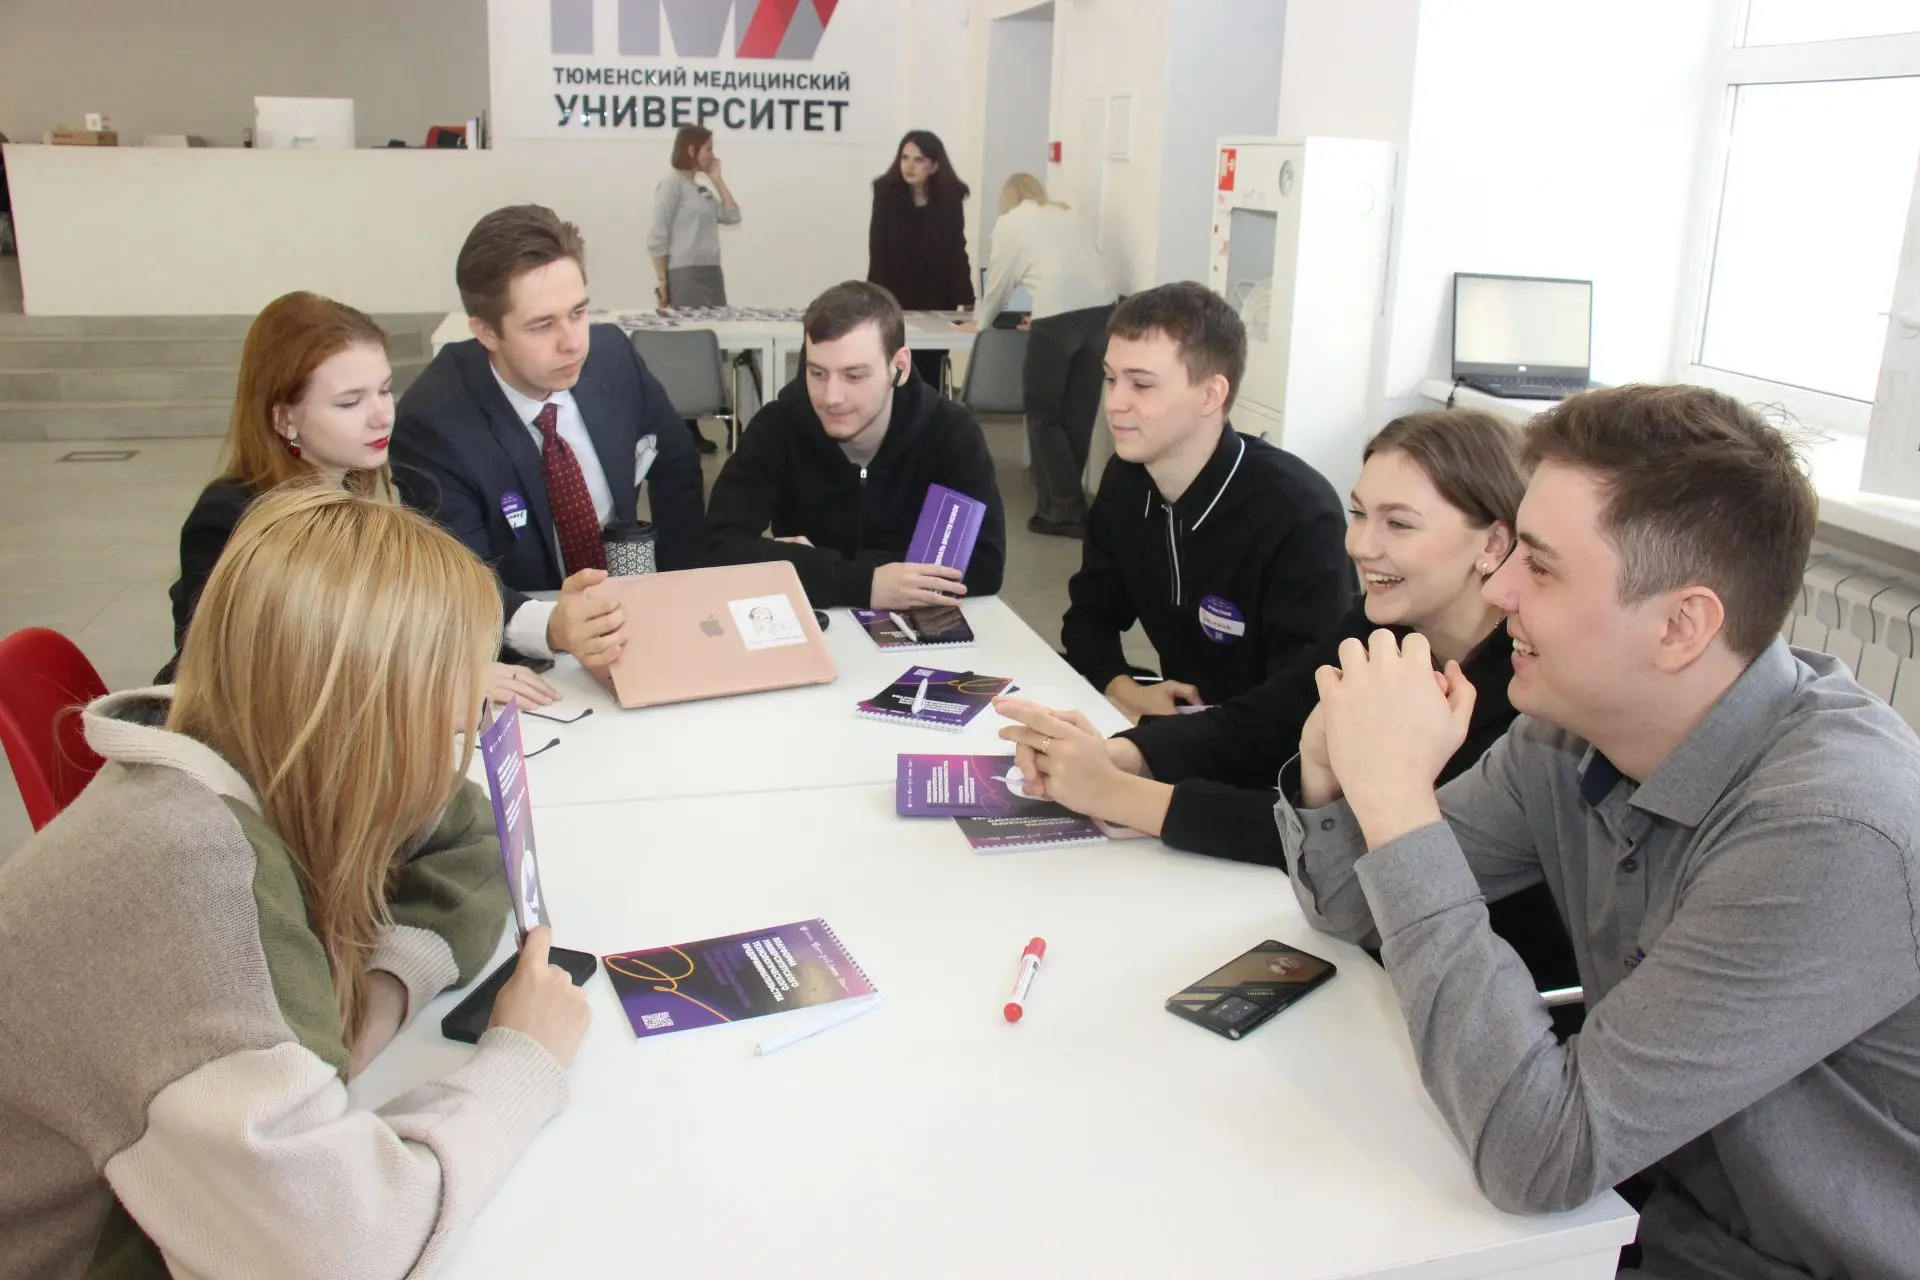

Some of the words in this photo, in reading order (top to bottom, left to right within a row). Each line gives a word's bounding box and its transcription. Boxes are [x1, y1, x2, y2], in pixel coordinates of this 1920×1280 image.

[553, 66, 686, 88] ТЮМЕНСКИЙ
[693, 70, 850, 92] МЕДИЦИНСКИЙ
[554, 94, 849, 132] УНИВЕРСИТЕТ
